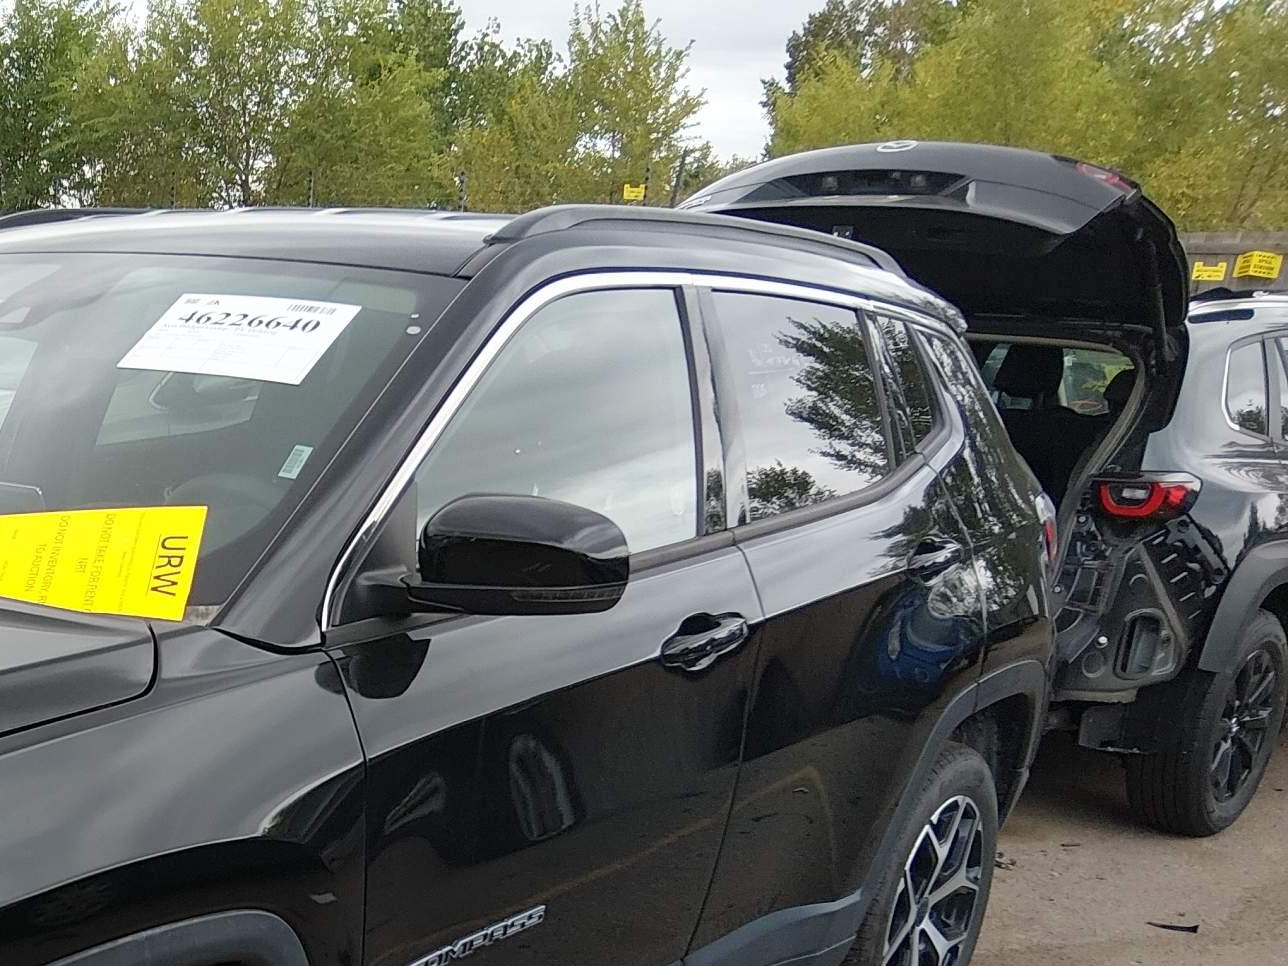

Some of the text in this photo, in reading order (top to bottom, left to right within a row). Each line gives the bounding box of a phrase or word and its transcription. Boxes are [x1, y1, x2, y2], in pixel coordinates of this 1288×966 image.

[178, 310, 321, 333] 46226640
[99, 526, 113, 543] NOT
[93, 544, 110, 565] TAKE
[150, 535, 189, 597] URW
[24, 554, 42, 592] AUCTION
